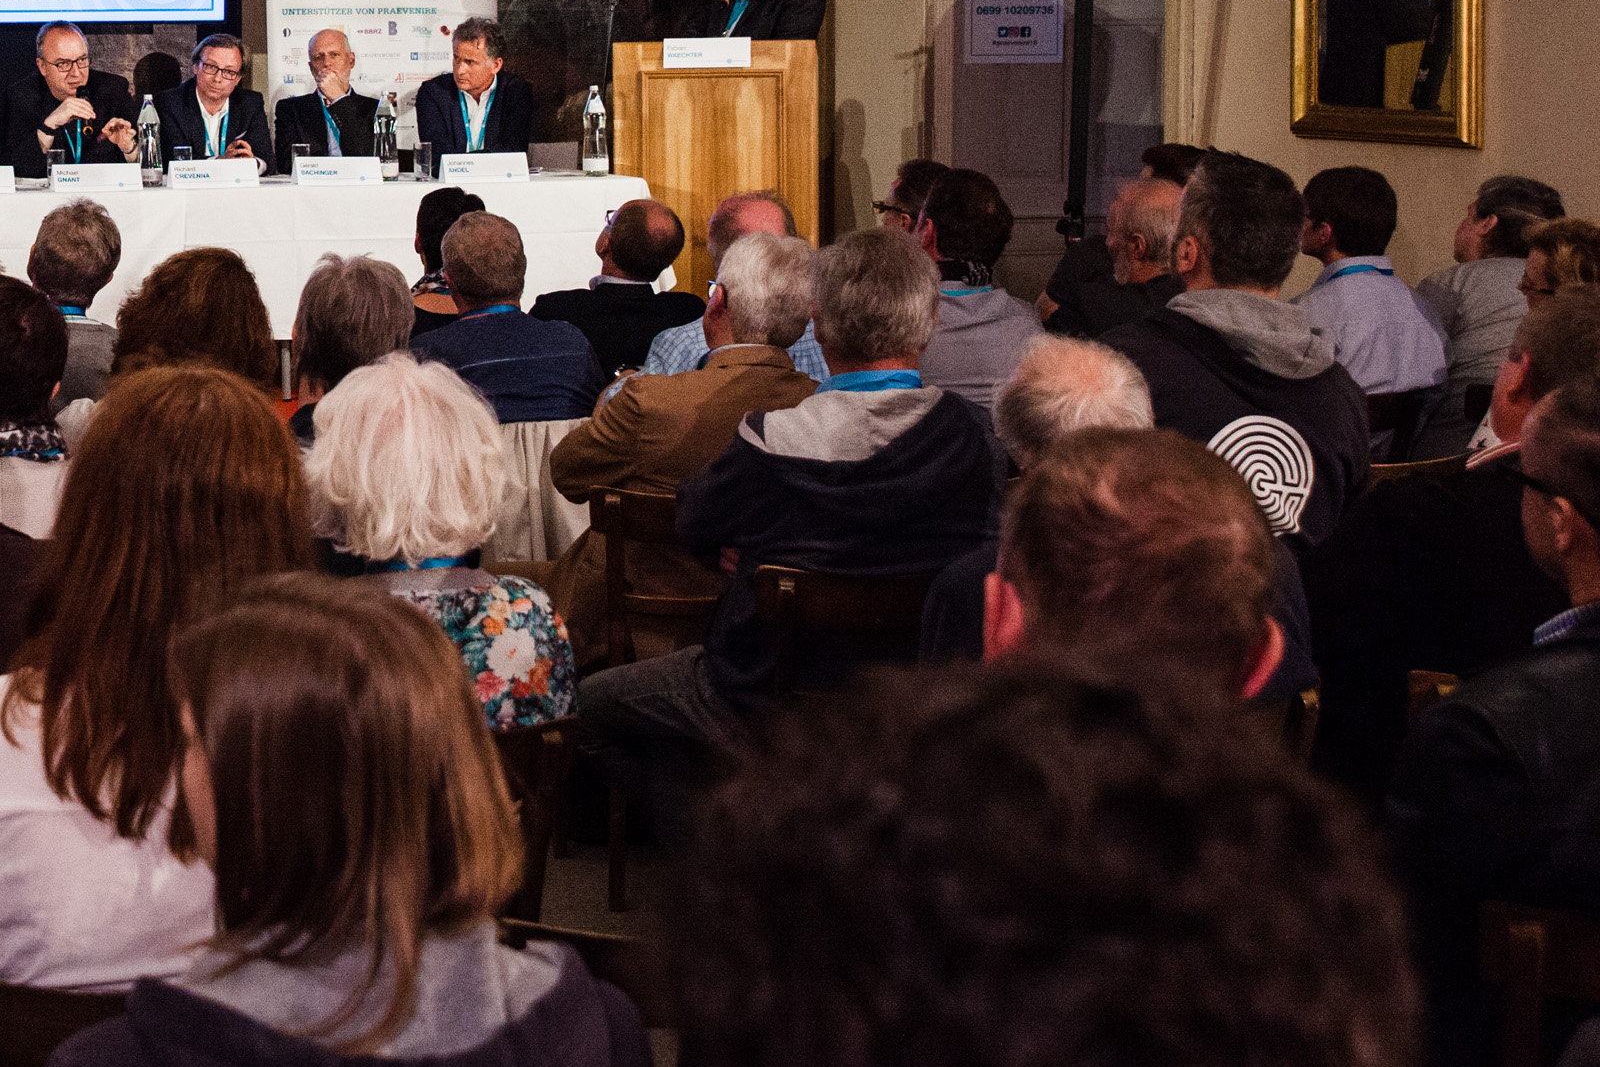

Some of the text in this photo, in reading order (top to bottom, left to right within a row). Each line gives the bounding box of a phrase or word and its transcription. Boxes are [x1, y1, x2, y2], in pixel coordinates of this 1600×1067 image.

[281, 7, 353, 15] UNTERSTÜTZER
[976, 6, 1054, 15] 0699 10209736
